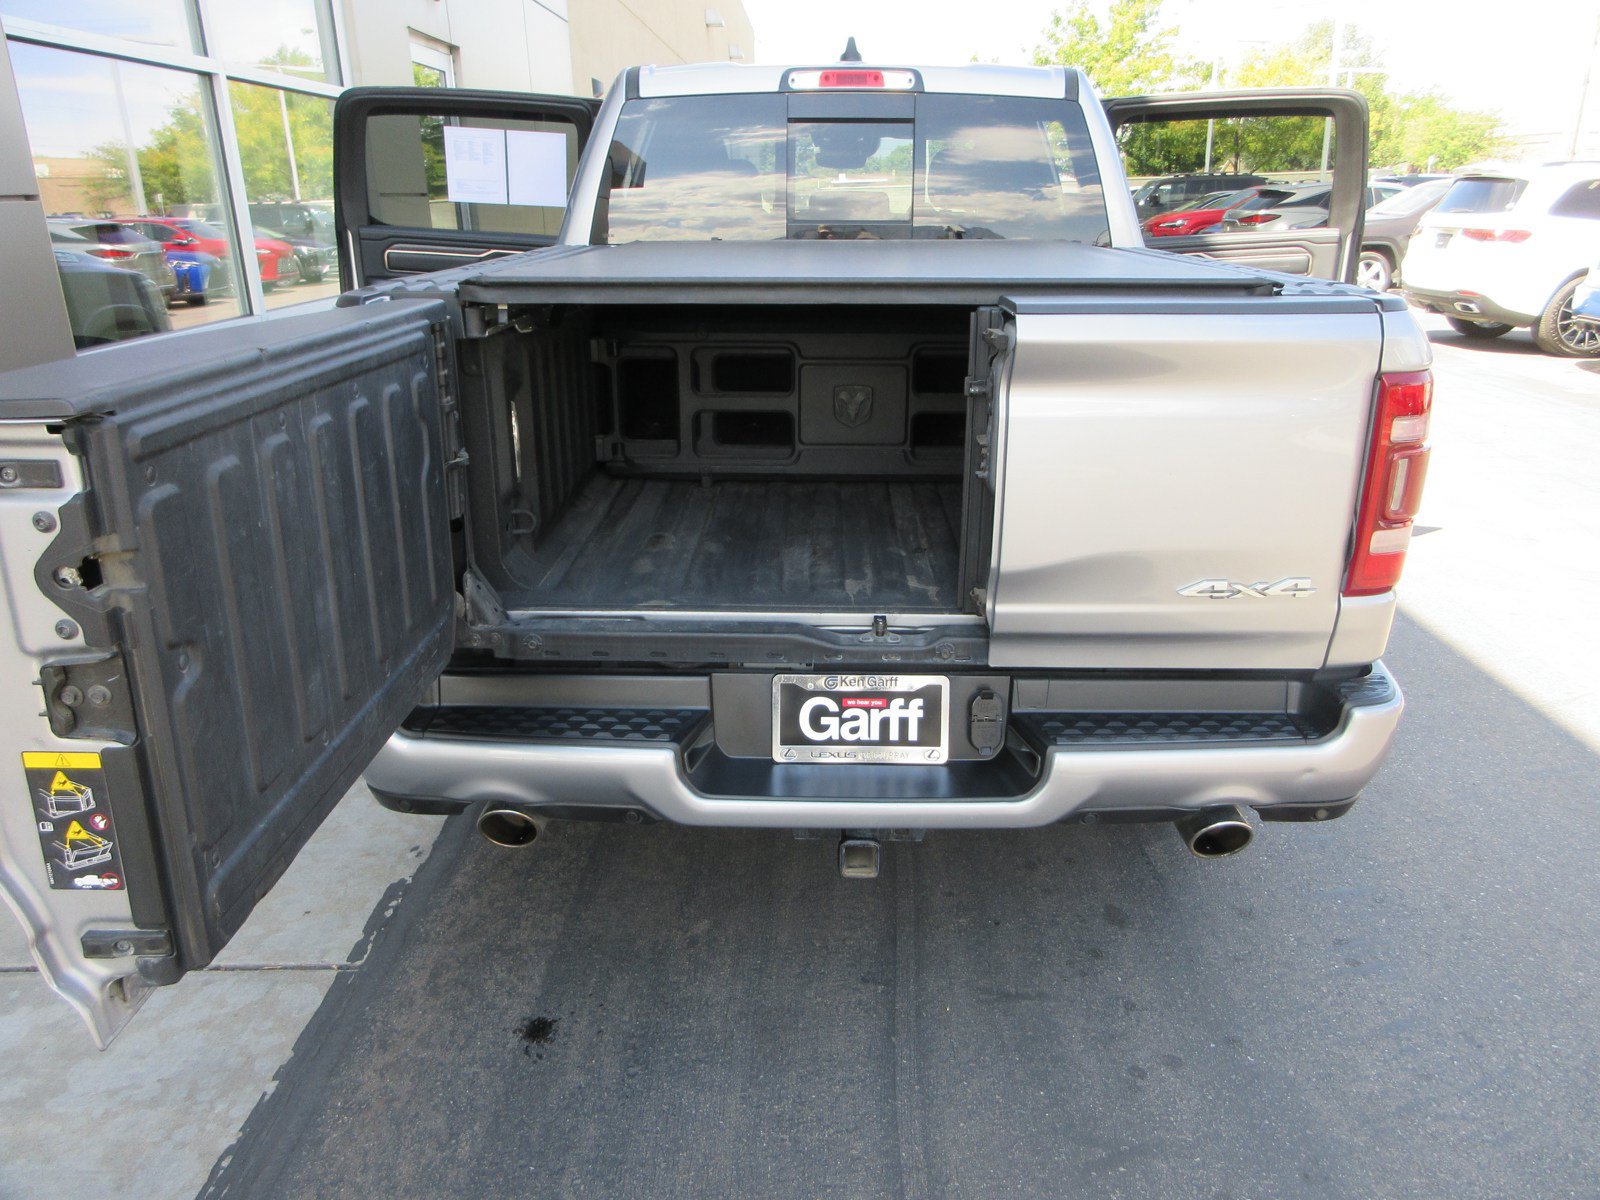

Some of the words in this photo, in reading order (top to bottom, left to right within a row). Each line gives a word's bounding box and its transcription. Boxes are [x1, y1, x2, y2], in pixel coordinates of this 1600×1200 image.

[840, 676, 865, 687] Ken
[867, 676, 899, 687] Garff
[799, 696, 924, 742] Garff
[810, 751, 857, 759] LEXUS
